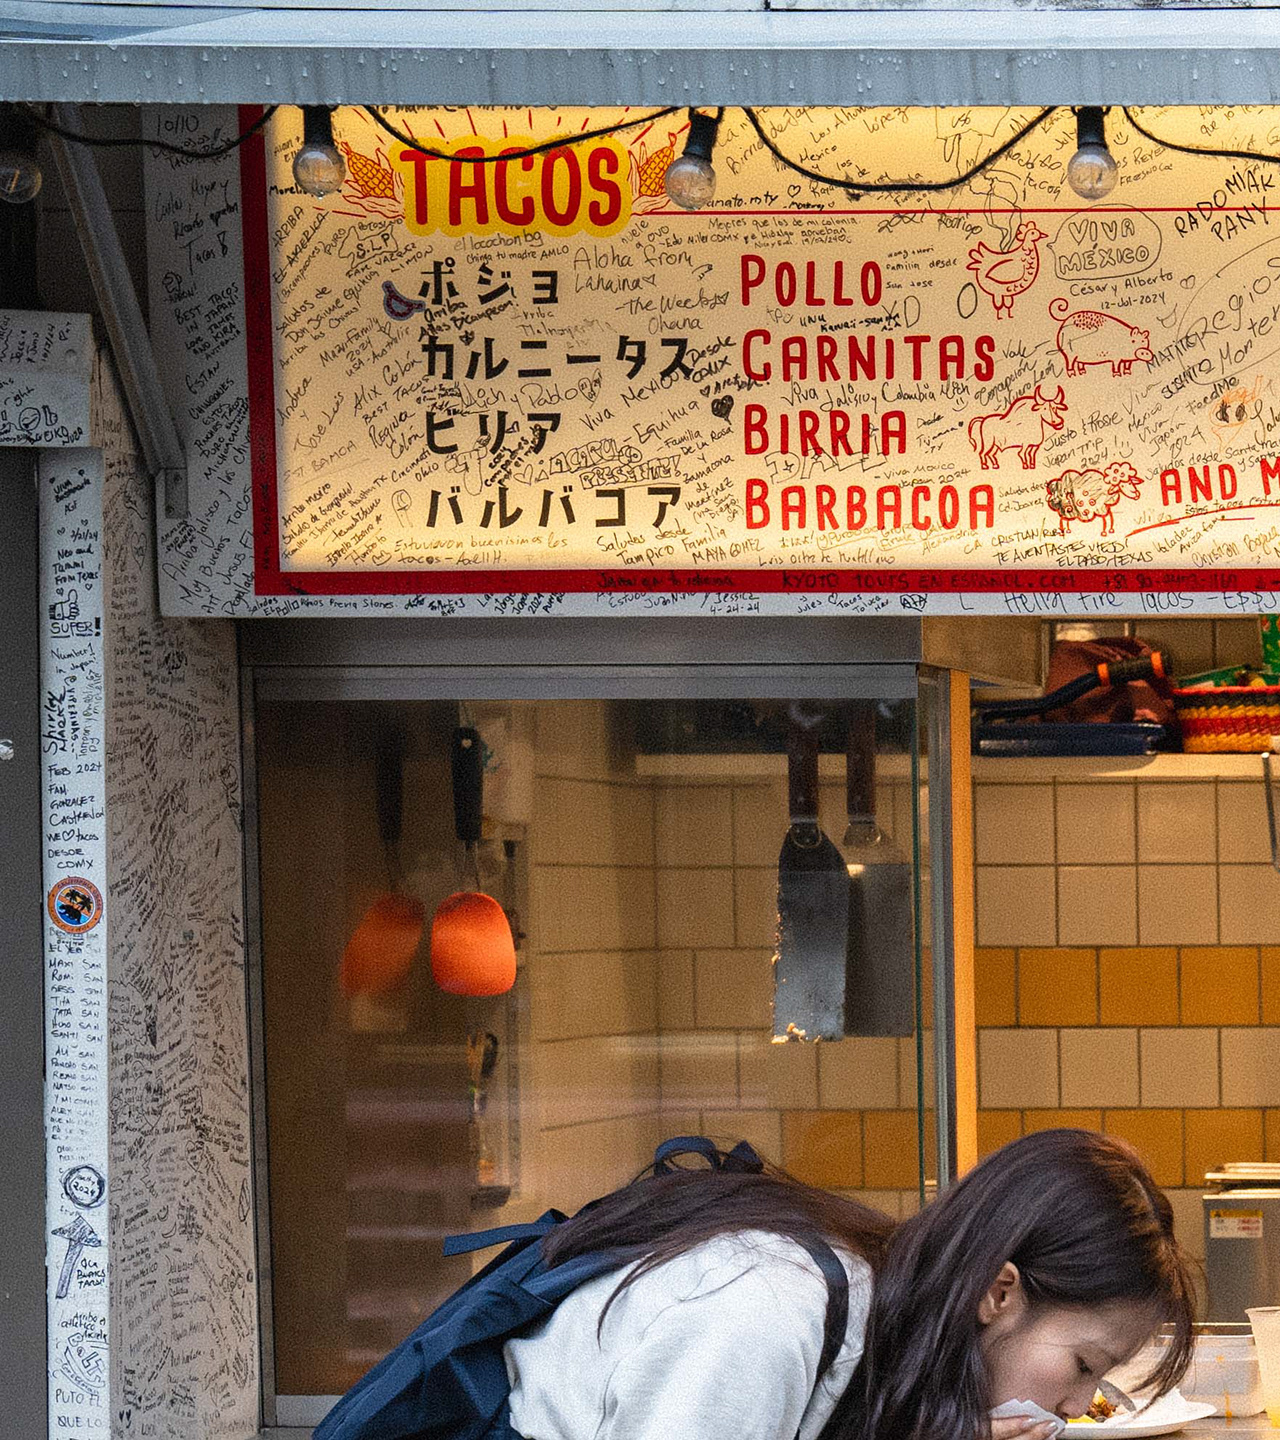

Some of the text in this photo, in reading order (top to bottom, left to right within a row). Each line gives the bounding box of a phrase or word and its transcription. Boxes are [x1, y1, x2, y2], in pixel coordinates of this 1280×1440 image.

[400, 146, 621, 226] TACOS
[741, 254, 882, 307] POLLO
[742, 329, 995, 382] CARNITAS
[744, 403, 907, 456] BIRRIA
[427, 485, 681, 529] バルバコア
[745, 478, 995, 530] BARBACOA
[1159, 463, 1238, 502] AND
